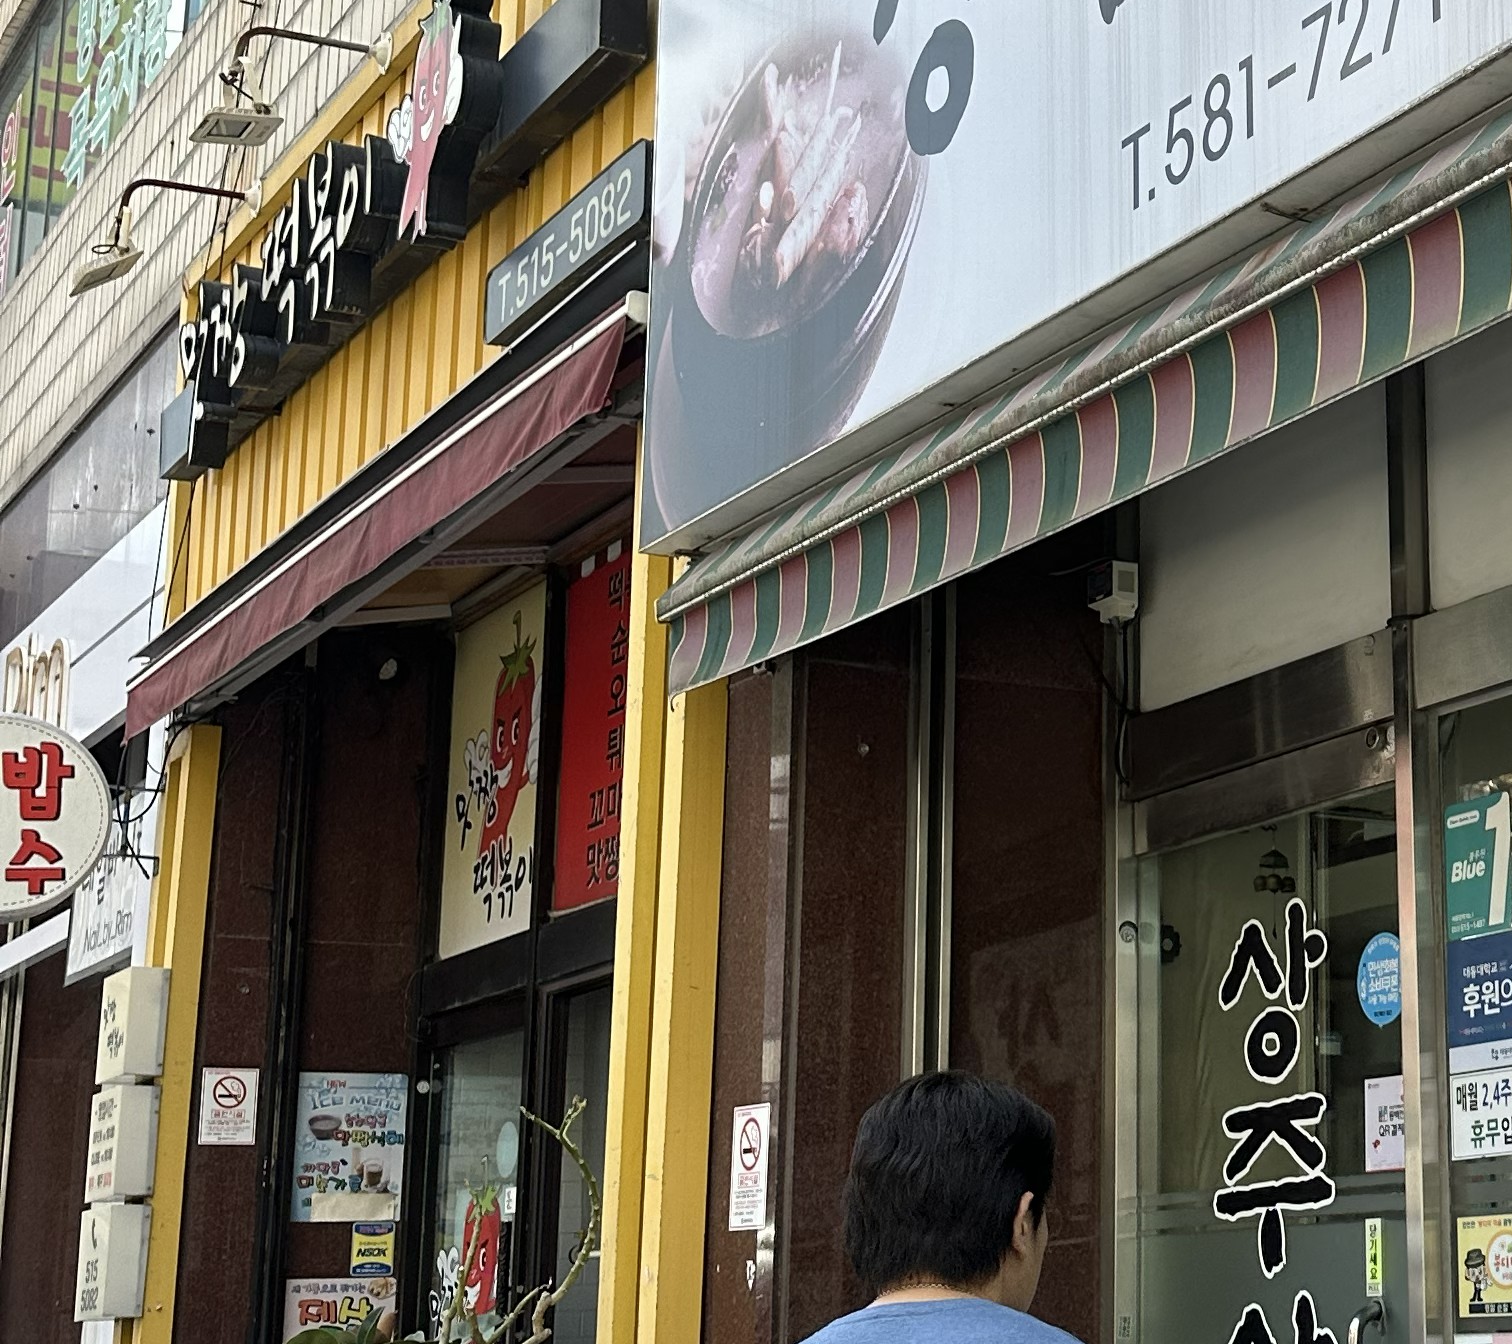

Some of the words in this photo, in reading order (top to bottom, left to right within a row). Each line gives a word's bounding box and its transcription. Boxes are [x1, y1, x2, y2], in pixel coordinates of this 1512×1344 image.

[498, 167, 632, 324] T.515-5082
[1451, 859, 1486, 884] Blue
[1462, 961, 1498, 979] 대동대학교
[311, 1096, 344, 1110] ICE
[1456, 1082, 1478, 1112] 매월
[1482, 1078, 1512, 1110] 2,4주
[85, 1258, 99, 1284] 515
